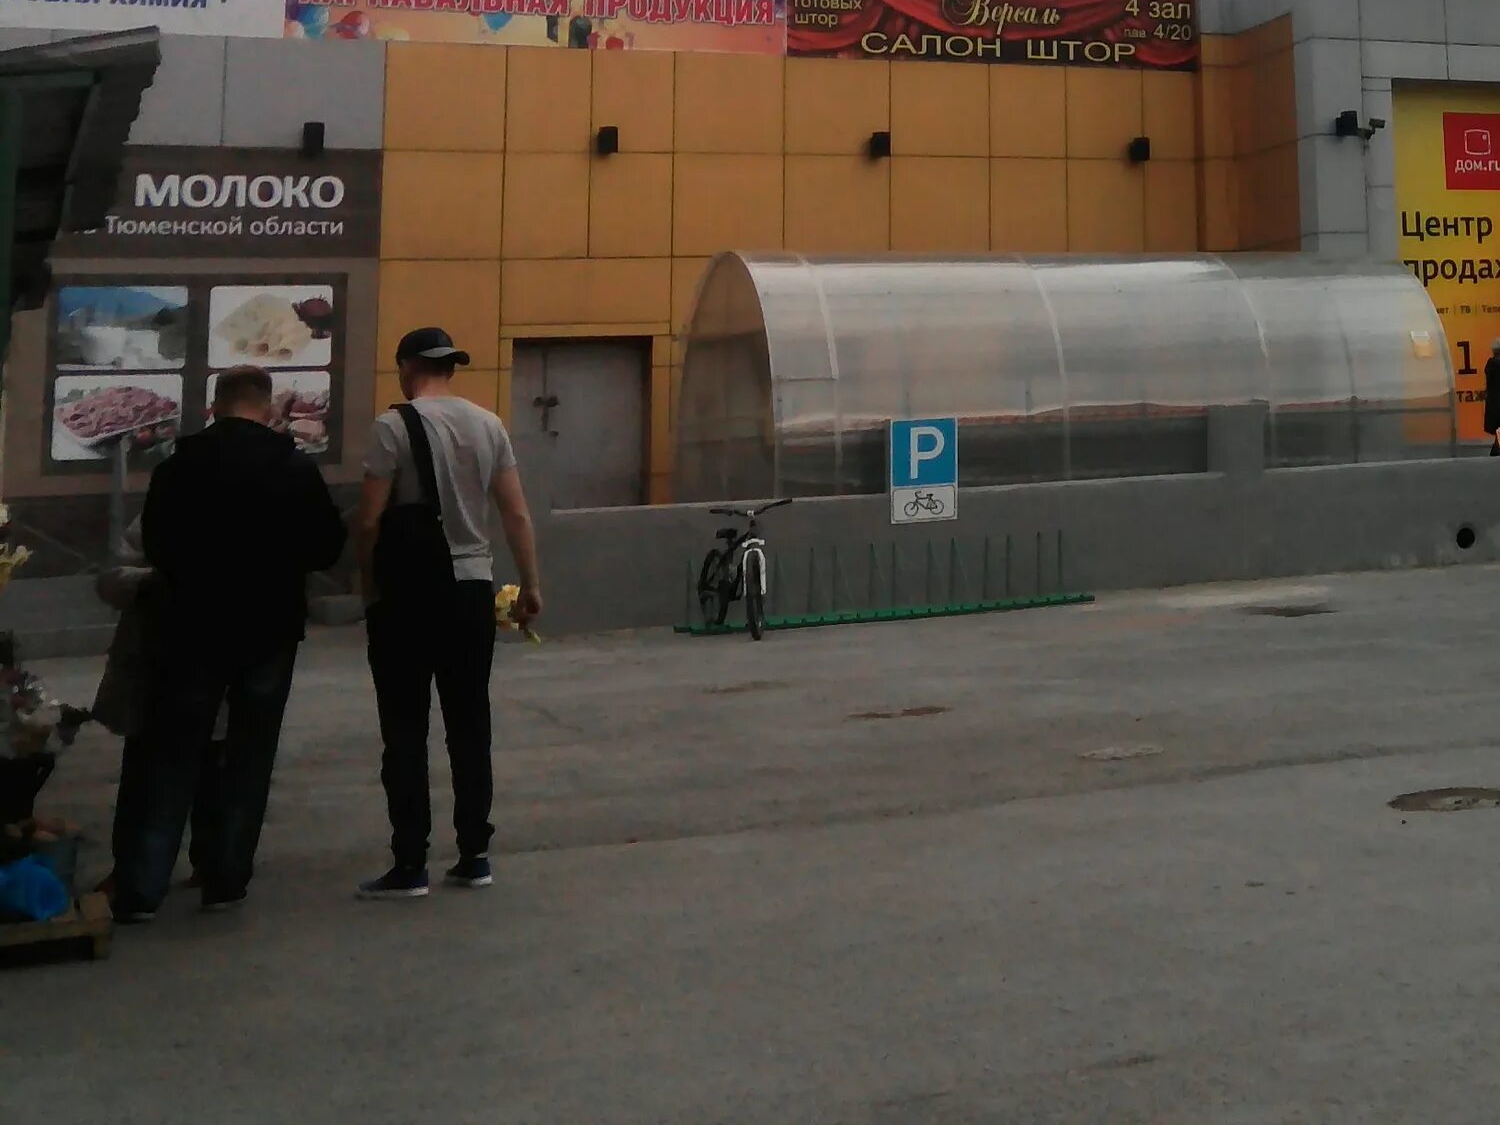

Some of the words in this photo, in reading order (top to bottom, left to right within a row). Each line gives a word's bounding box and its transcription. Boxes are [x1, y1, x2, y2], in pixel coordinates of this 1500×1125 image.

[794, 12, 838, 27] штор
[1148, 1, 1191, 20] зал
[861, 32, 1001, 58] САЛОН
[1027, 38, 1136, 63] ШТОР
[1153, 23, 1192, 41] 4/20
[134, 173, 345, 209] МОЛОКО
[105, 215, 242, 237] Тюменской
[249, 215, 344, 237] области
[1401, 210, 1494, 244] Центр
[1457, 341, 1478, 374] 1
[910, 426, 945, 480] P
